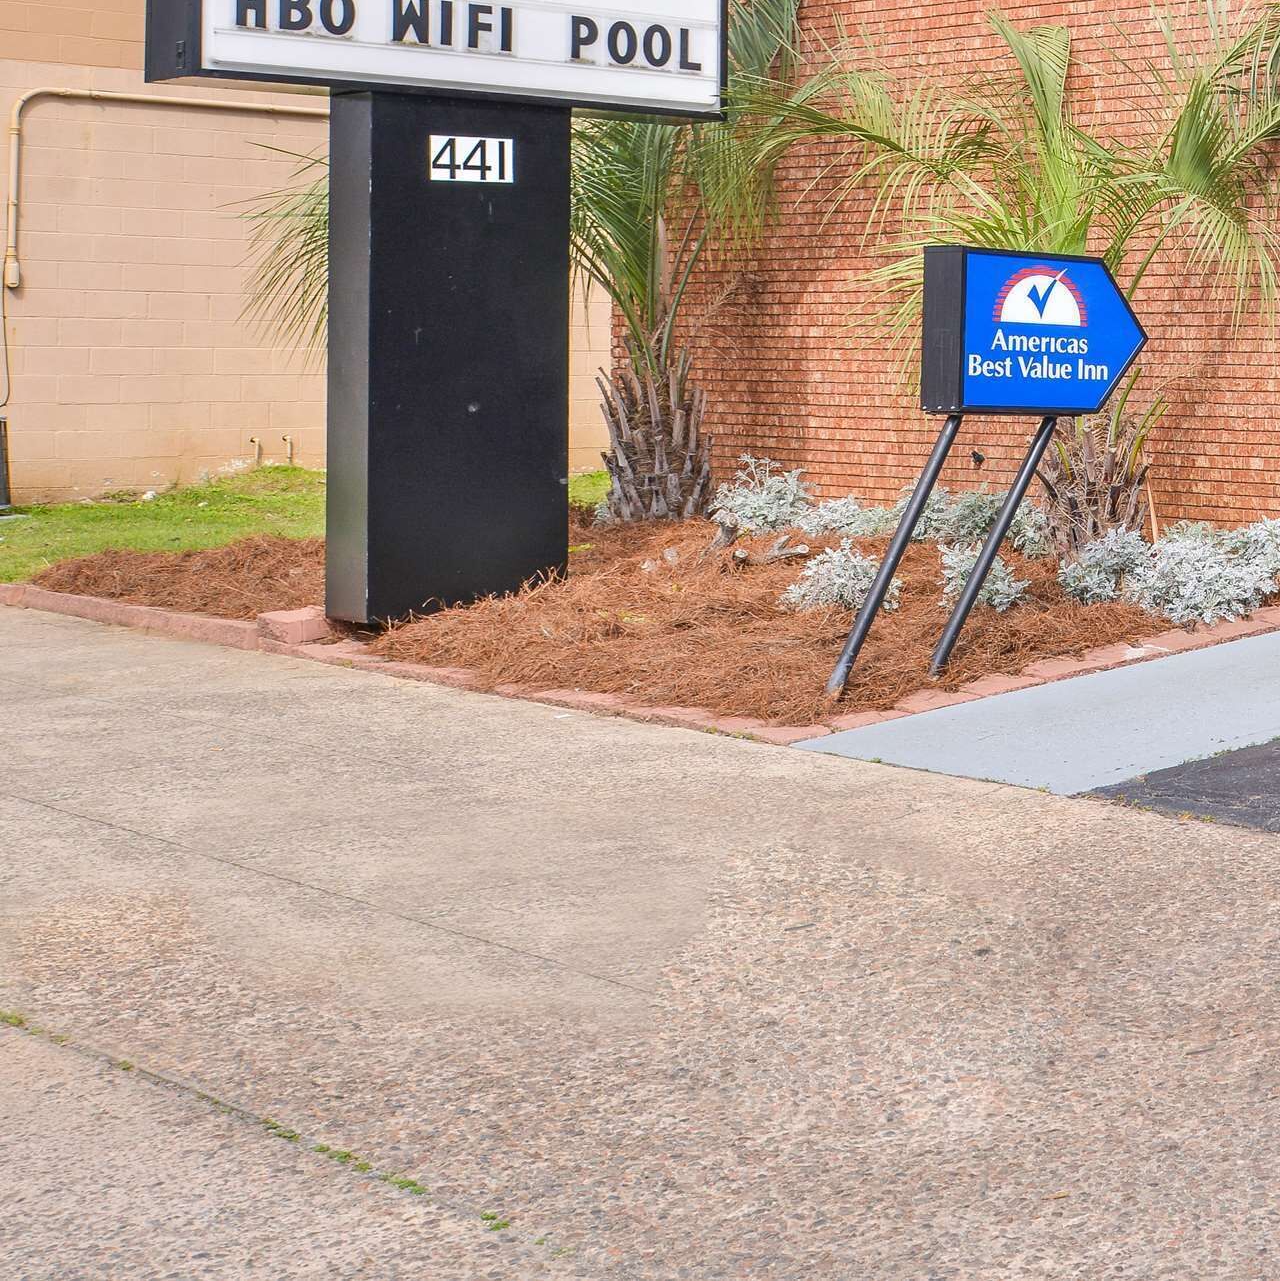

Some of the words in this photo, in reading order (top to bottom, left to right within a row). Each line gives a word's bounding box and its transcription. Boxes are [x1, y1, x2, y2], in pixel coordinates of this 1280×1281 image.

[570, 15, 702, 72] POOL
[432, 137, 505, 181] 441
[991, 328, 1089, 355] Americas
[968, 354, 1013, 378] Best
[1017, 356, 1073, 380] Value
[1077, 358, 1109, 381] Inn
